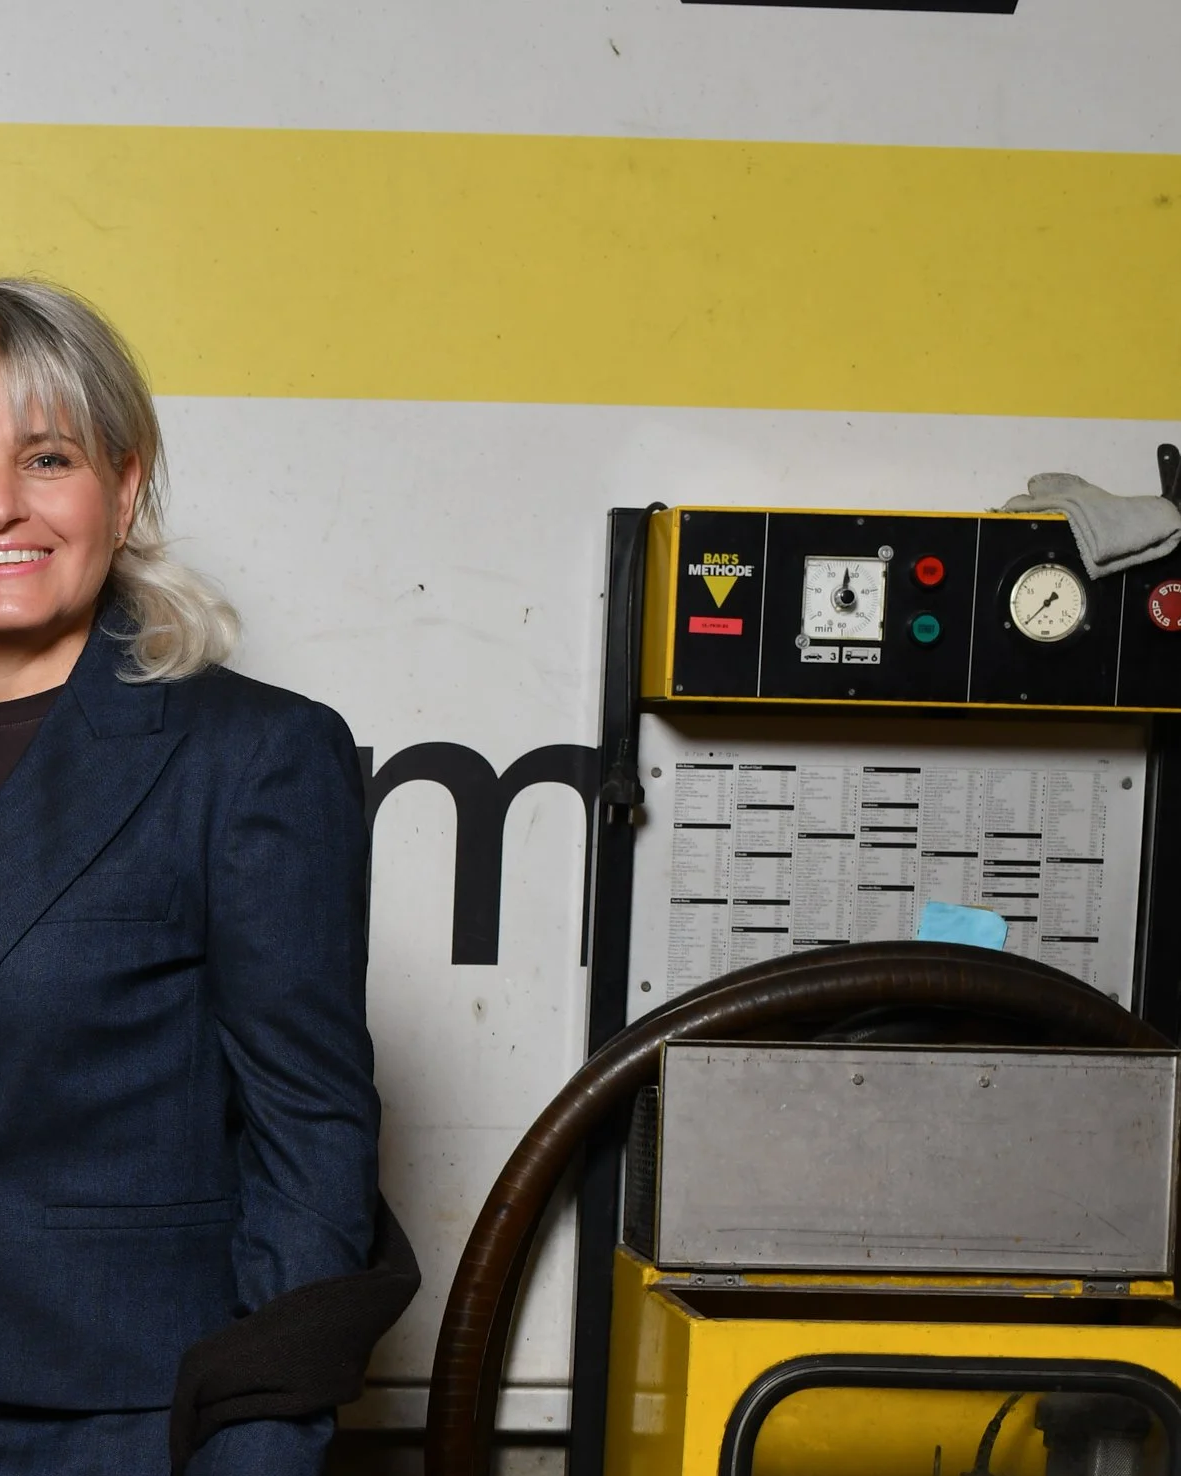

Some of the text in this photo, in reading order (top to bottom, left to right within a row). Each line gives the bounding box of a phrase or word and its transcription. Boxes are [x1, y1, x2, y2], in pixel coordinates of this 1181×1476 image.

[703, 553, 739, 565] BAR'S
[688, 564, 753, 577] METHODE
[1159, 583, 1181, 596] STO
[1152, 600, 1170, 627] STOP
[815, 625, 833, 633] min
[830, 652, 837, 661] 3
[871, 654, 878, 662] 6
